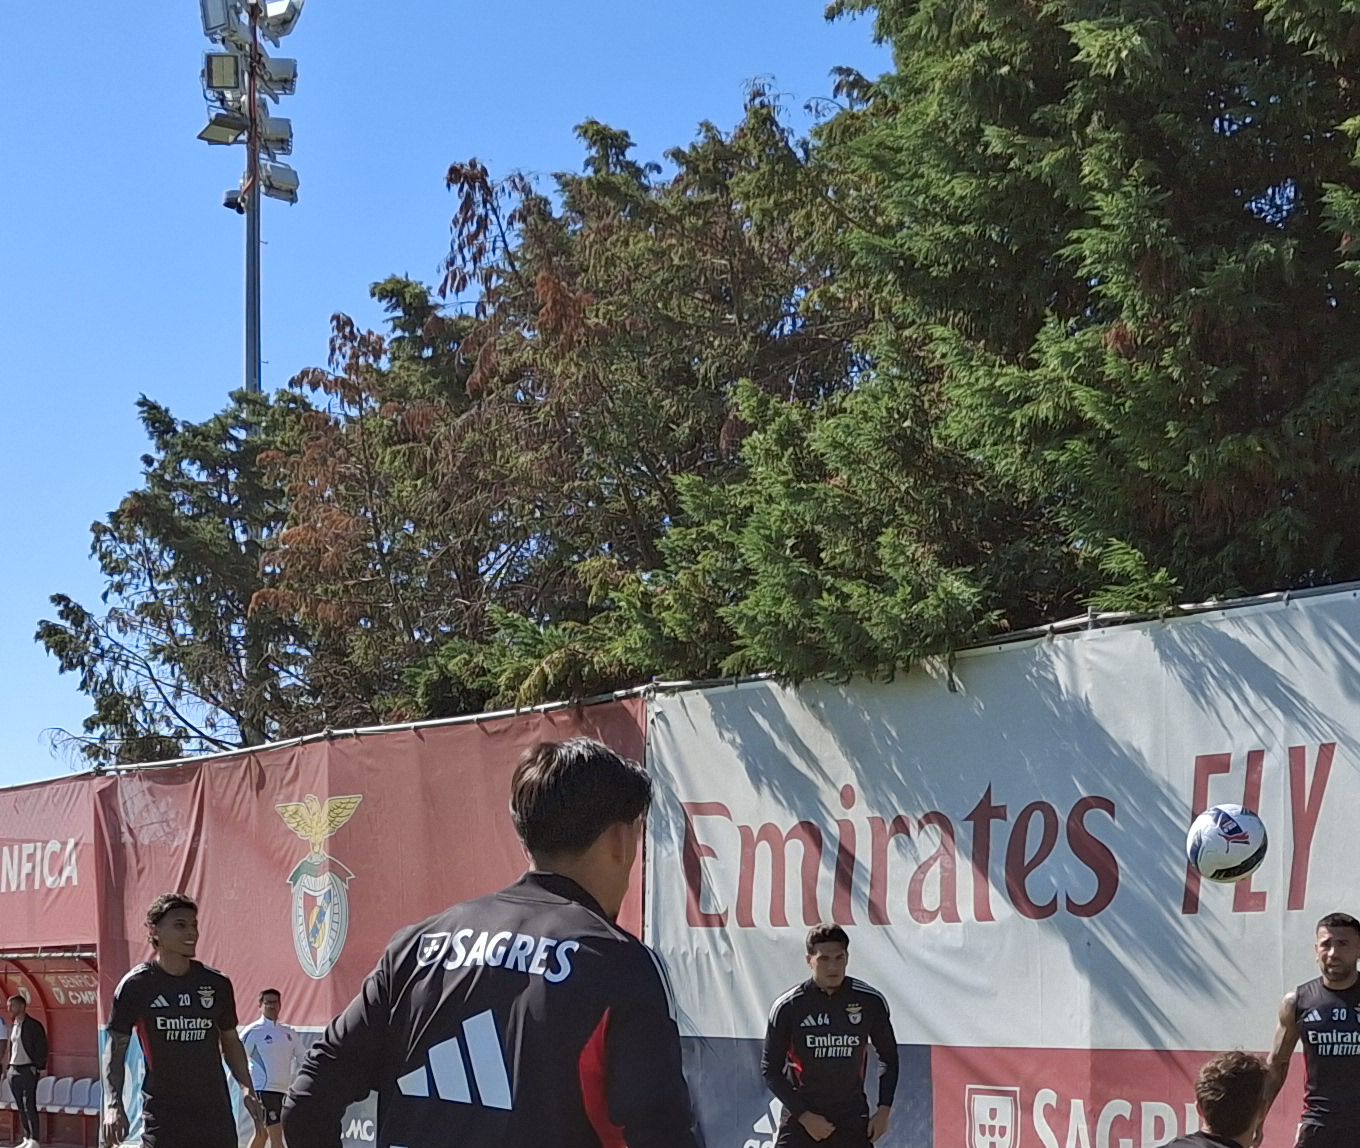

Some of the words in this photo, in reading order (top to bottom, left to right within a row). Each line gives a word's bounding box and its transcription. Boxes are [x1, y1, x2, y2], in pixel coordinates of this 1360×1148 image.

[1181, 742, 1337, 915] FLY
[682, 781, 1120, 928] Emirates
[443, 928, 580, 983] SAGRES
[178, 993, 191, 1006] 20
[817, 1013, 830, 1025] 64
[1332, 1008, 1347, 1021] 30
[156, 1015, 213, 1030] Emirates
[166, 1030, 179, 1040] FLY
[181, 1030, 207, 1041] BETTER
[806, 1034, 860, 1048] Emirates
[814, 1047, 826, 1058] FLY
[827, 1046, 853, 1058] BETTER
[1318, 1045, 1331, 1056] FLY
